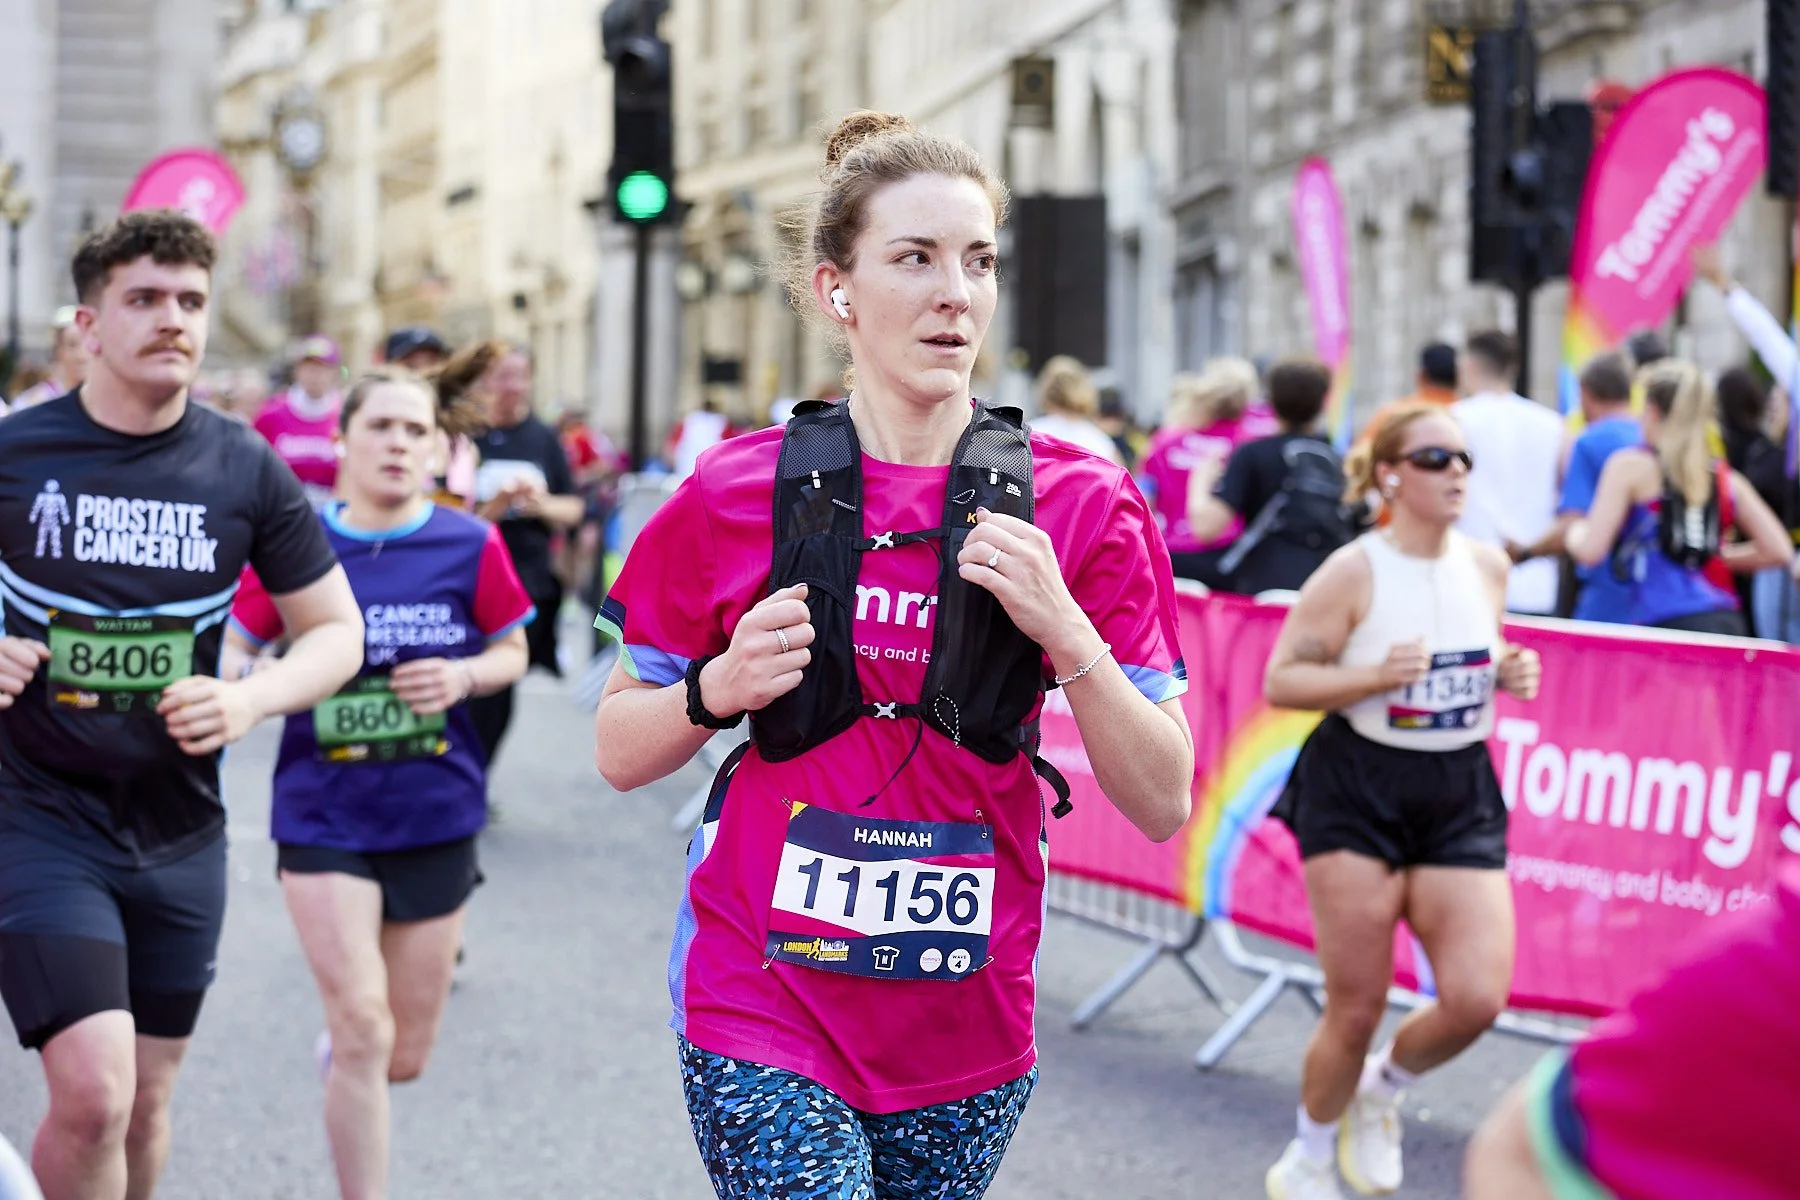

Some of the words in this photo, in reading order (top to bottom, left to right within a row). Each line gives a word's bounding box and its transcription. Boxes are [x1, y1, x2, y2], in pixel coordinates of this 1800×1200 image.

[1596, 107, 1734, 281] Tommy's
[75, 494, 207, 539] PROSTATE
[74, 527, 179, 569] CANCER
[181, 536, 218, 573] UK
[366, 604, 452, 626] CANCER
[366, 623, 466, 646] RESEARCH
[69, 642, 172, 678] 8406
[367, 646, 398, 666] UK
[884, 647, 917, 662] and
[335, 699, 421, 735] 860
[854, 827, 932, 848] HANNAH
[798, 857, 980, 926] 11156
[783, 941, 812, 953] LONDON
[954, 960, 962, 969] 4
